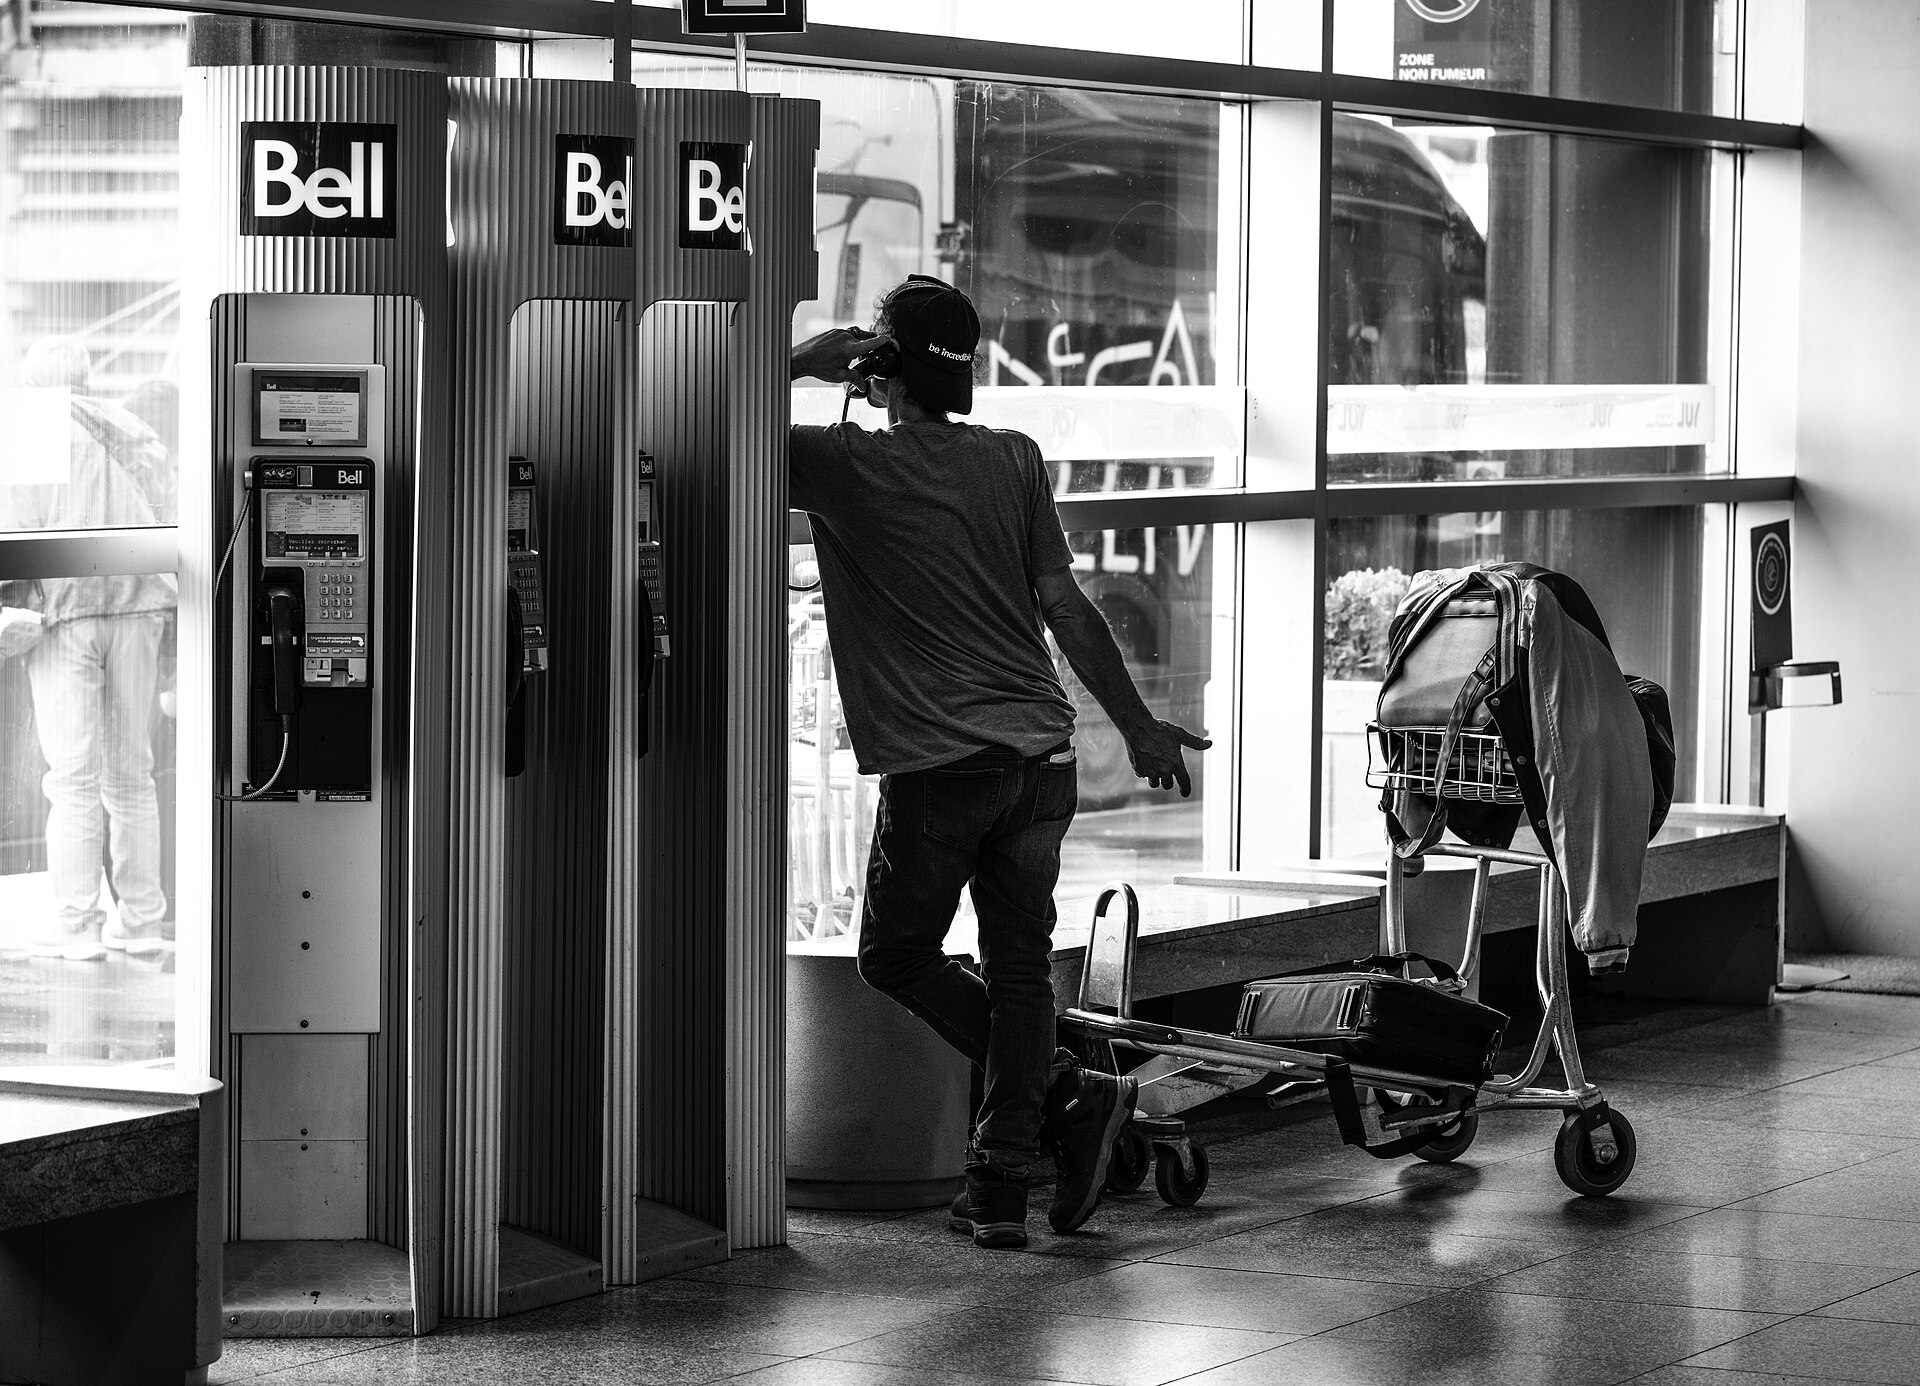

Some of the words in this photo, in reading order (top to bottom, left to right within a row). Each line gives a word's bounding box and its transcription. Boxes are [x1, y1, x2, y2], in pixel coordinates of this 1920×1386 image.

[1399, 53, 1435, 66] ZONE
[1399, 68, 1428, 80] NON
[1431, 68, 1485, 80] FUMEUR
[254, 139, 384, 219] Bell
[928, 342, 940, 354] be
[519, 466, 533, 480] Bell
[640, 460, 653, 474] Bell
[337, 469, 363, 485] Bell
